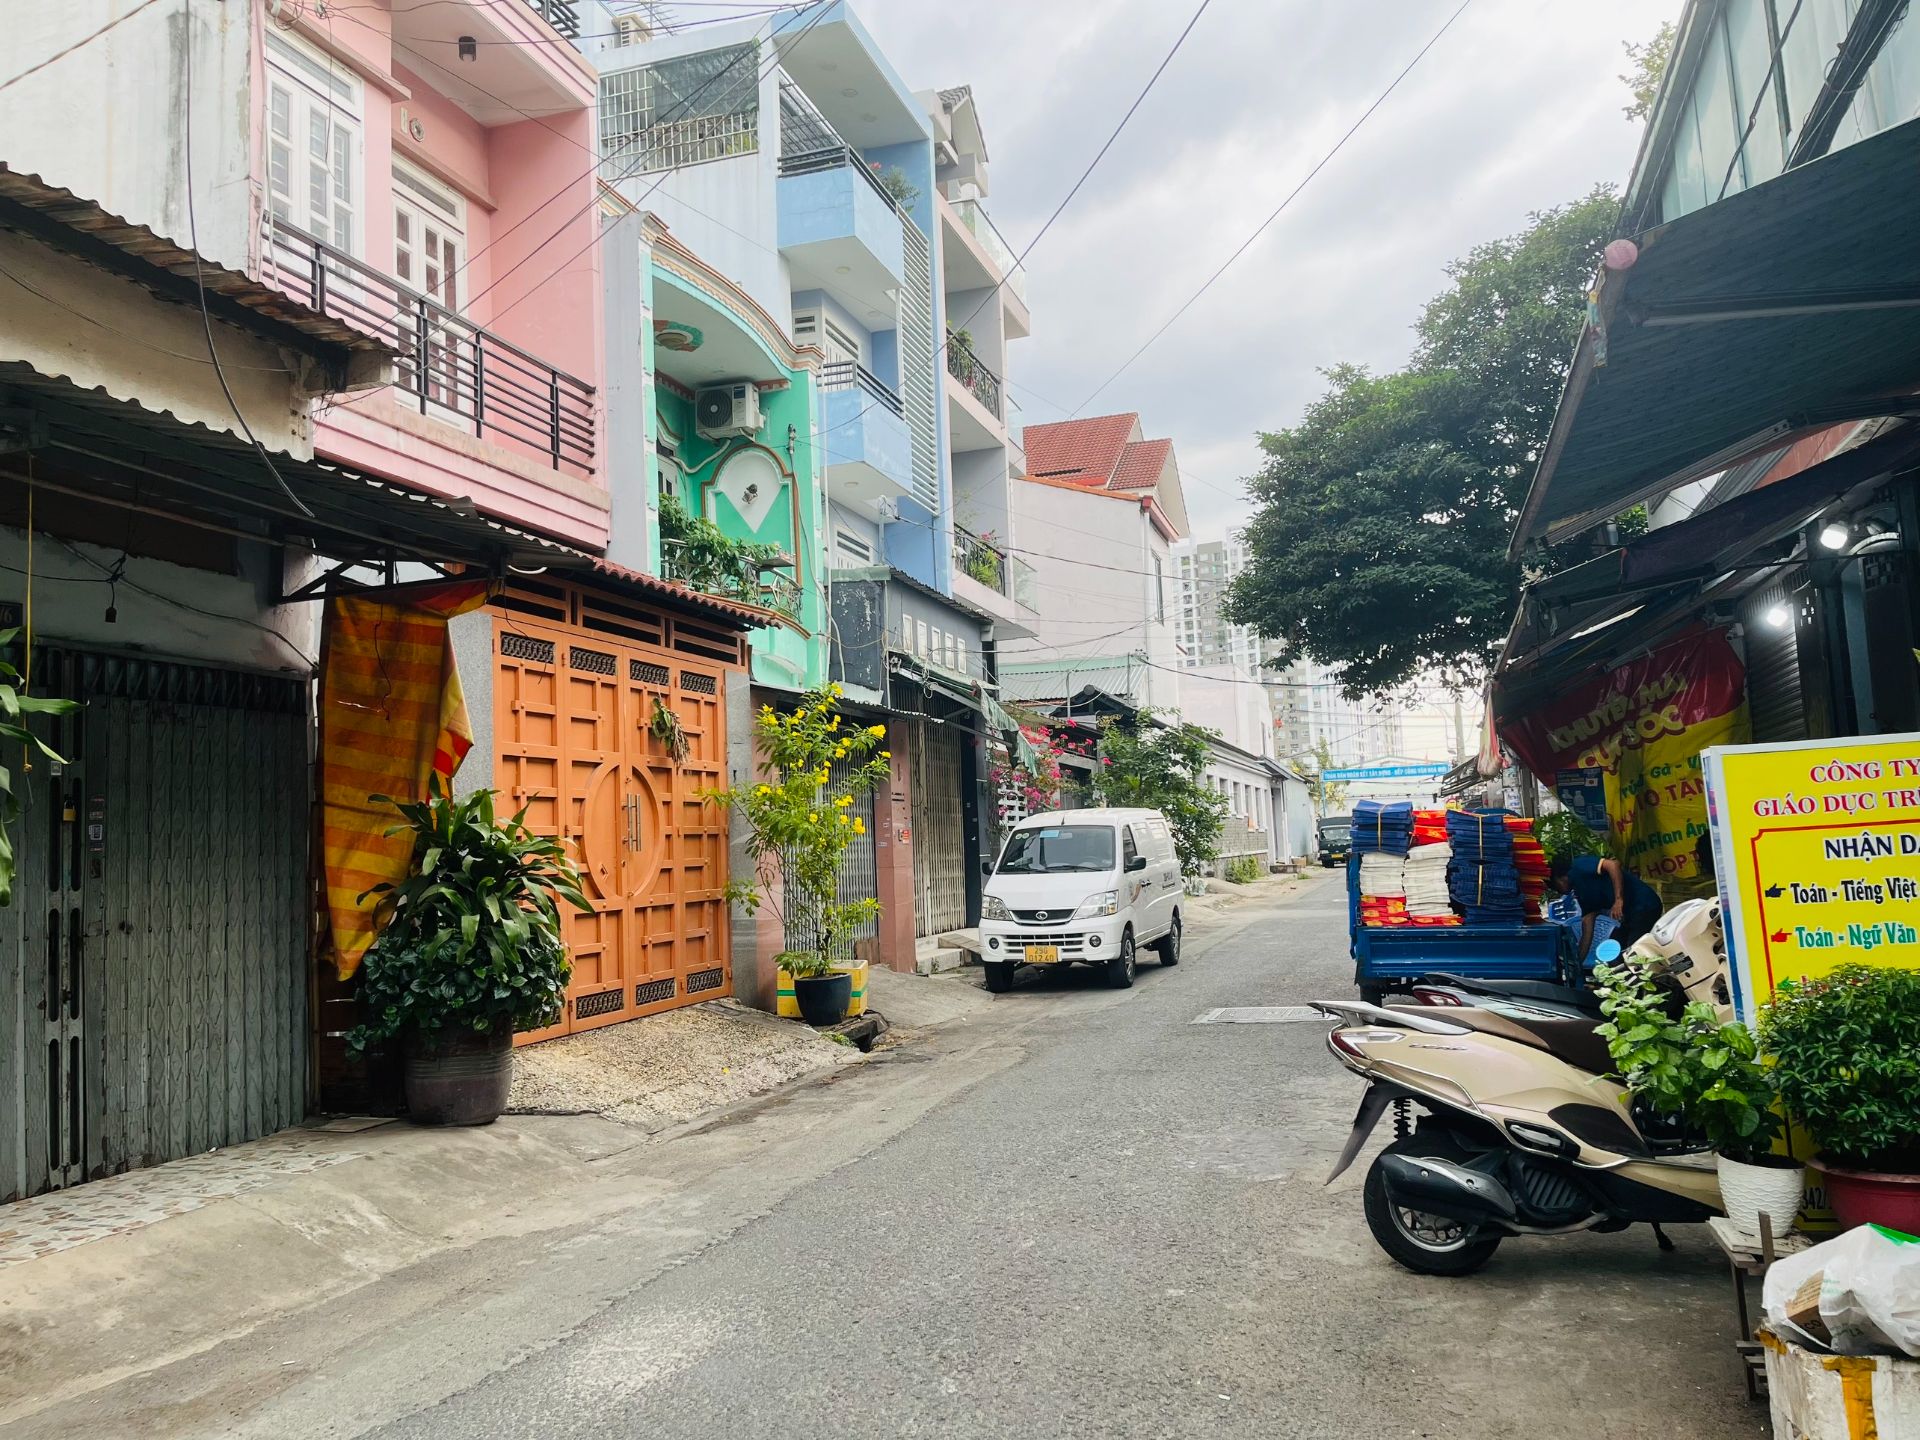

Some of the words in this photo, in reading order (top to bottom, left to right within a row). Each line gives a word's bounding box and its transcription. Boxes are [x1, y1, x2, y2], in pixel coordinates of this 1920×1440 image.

[1810, 760, 1880, 782] CÔNG
[1888, 758, 1920, 777] TY
[1754, 793, 1816, 816] GIÁO
[1824, 792, 1875, 815] DỤC
[1882, 786, 1920, 808] TR
[1825, 832, 1892, 862] NHẬN
[1900, 834, 1920, 854] D
[1790, 882, 1828, 904] Toán
[1841, 878, 1882, 904] Tiếng
[1886, 877, 1917, 902] Việt
[1795, 926, 1834, 948] Toán
[1848, 924, 1882, 950] Ngữ
[1884, 923, 1916, 944] Văn
